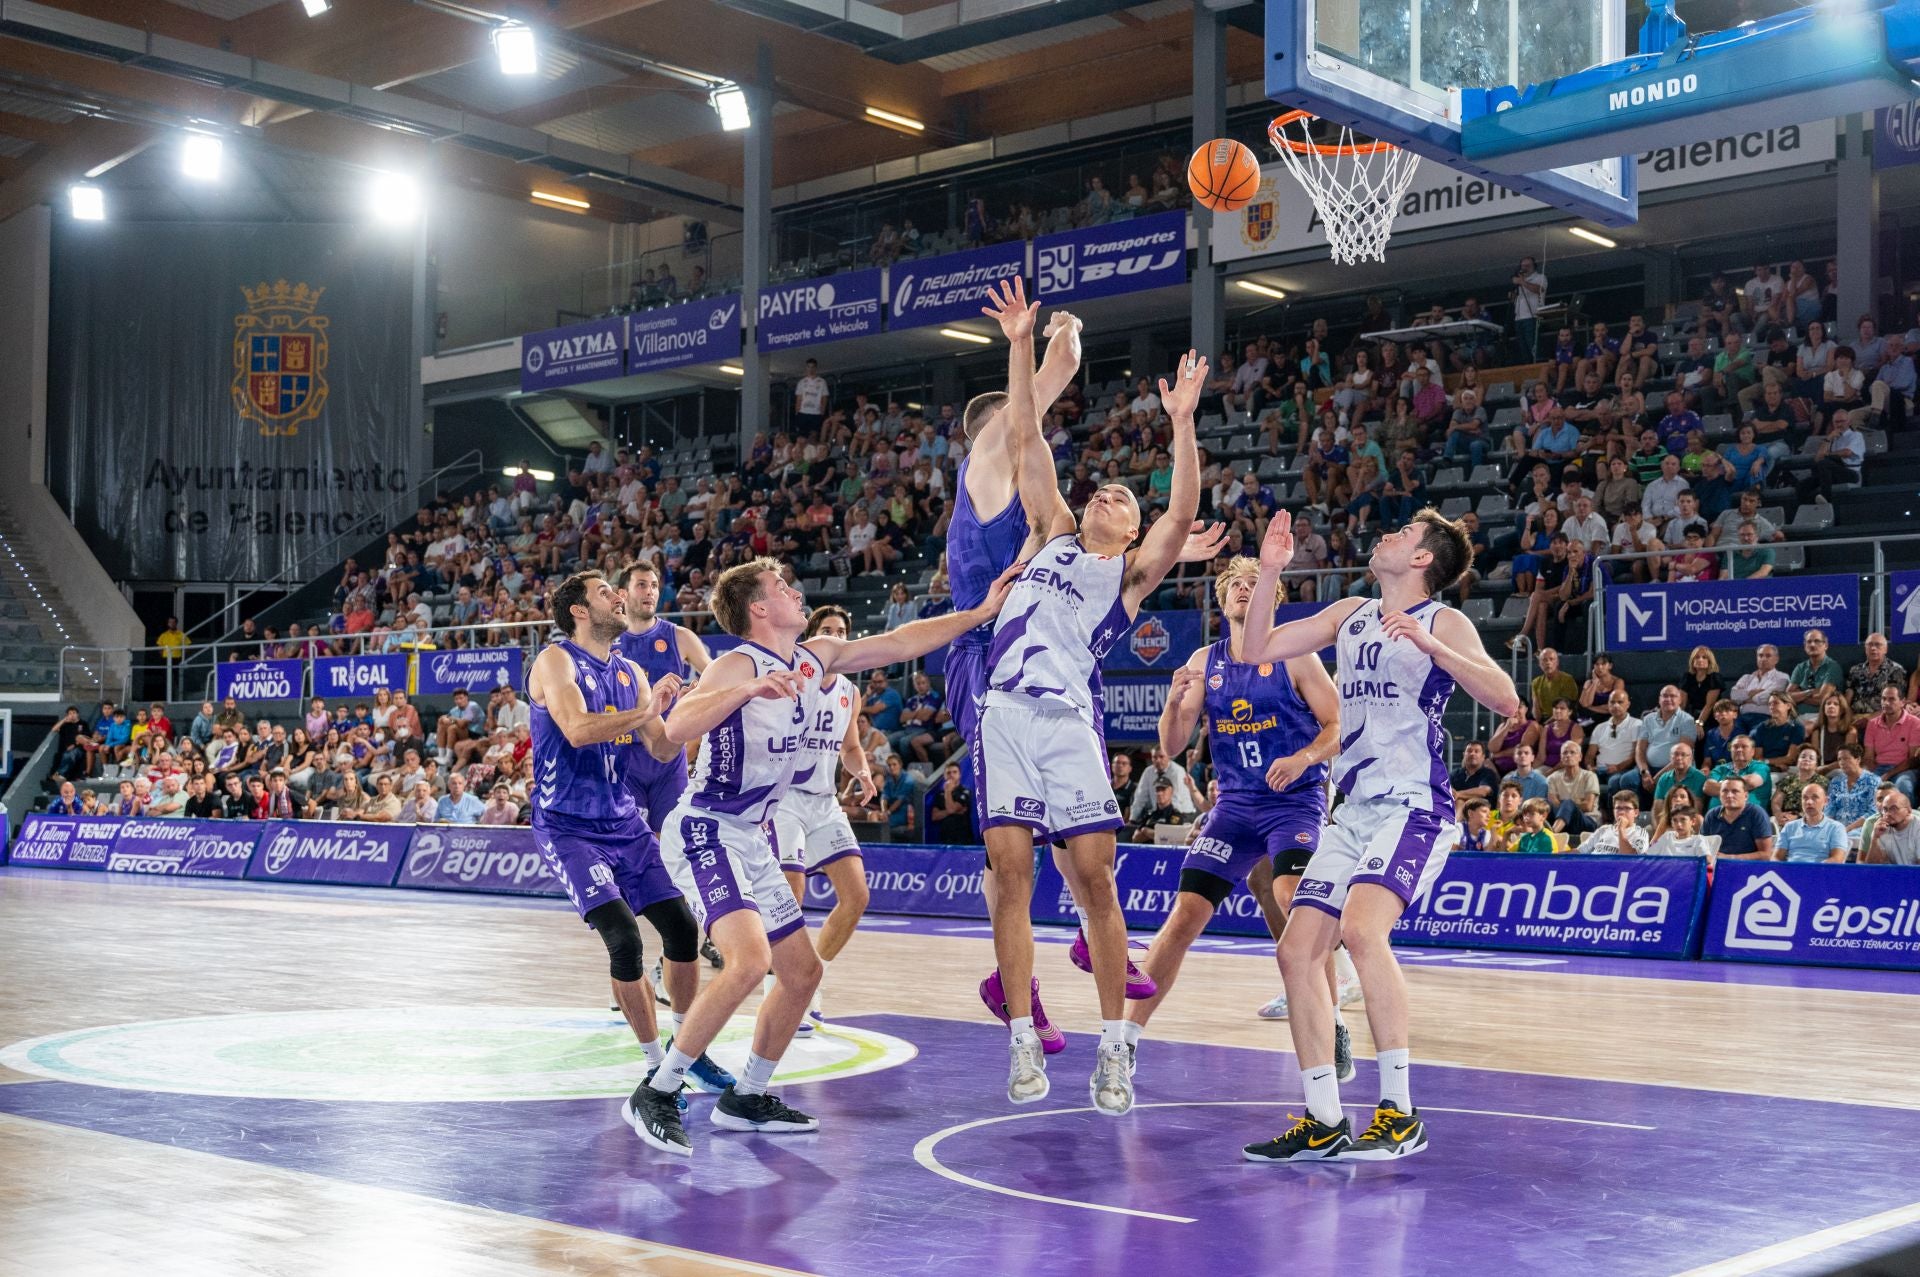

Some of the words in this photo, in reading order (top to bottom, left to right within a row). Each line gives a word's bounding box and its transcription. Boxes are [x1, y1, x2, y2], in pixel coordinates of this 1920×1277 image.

[1609, 73, 1698, 111] MONDO
[1638, 124, 1801, 173] alencia
[1082, 231, 1177, 257] Transportes
[919, 261, 1021, 291] NEUMÁTICOS
[1078, 249, 1181, 283] BUJ
[912, 284, 993, 310] PALENCIA
[634, 317, 678, 333] Interiorismo
[767, 330, 812, 345] Transporte
[814, 325, 826, 338] de
[828, 320, 869, 335] Vehículos
[547, 331, 619, 361] VAYMA
[634, 328, 707, 356] Villanova
[144, 458, 409, 497] Ayuntamiento
[164, 508, 209, 535] de
[228, 502, 388, 536] Palencia
[1674, 594, 1848, 616] MORALESCERVERA
[1685, 619, 1747, 633] Implantología
[1749, 619, 1781, 630] Dental
[1784, 617, 1832, 628] Inmediata
[1132, 637, 1167, 649] PALENCIA
[456, 651, 509, 664] AMBULANCIAS
[1355, 641, 1383, 671] 10
[236, 671, 285, 681] DESGUACE
[431, 653, 491, 691] Enrique
[229, 679, 291, 699] MUNDO
[1103, 683, 1170, 713] BIENVEN
[1342, 680, 1400, 700] UEMC
[815, 709, 834, 732] 12
[1123, 722, 1158, 731] PALEN
[1217, 715, 1278, 735] agropal
[1238, 741, 1263, 768] 13
[77, 822, 122, 840] FENDT
[343, 830, 377, 841] GRUPO
[13, 841, 67, 861] CASARES
[68, 842, 109, 863] VALTRA
[186, 840, 255, 859] MODOS
[300, 838, 401, 866] INMAPA
[450, 835, 492, 852] súper
[1191, 836, 1233, 860] gaza
[1153, 861, 1168, 876] H
[1396, 865, 1414, 886] CBC
[708, 885, 730, 902] CBC
[935, 869, 985, 900] ópti
[1295, 889, 1329, 899] HYUNDAI
[1125, 888, 1181, 913] REY
[1418, 870, 1670, 925] lambda
[1812, 897, 1920, 938] épsil
[1414, 916, 1499, 937] frigoríficas
[1515, 923, 1662, 944] www.proylam.es
[1808, 937, 1862, 949] SOLUCIONES
[1862, 938, 1905, 951] TÉRMICAS
[1905, 942, 1913, 951] Y
